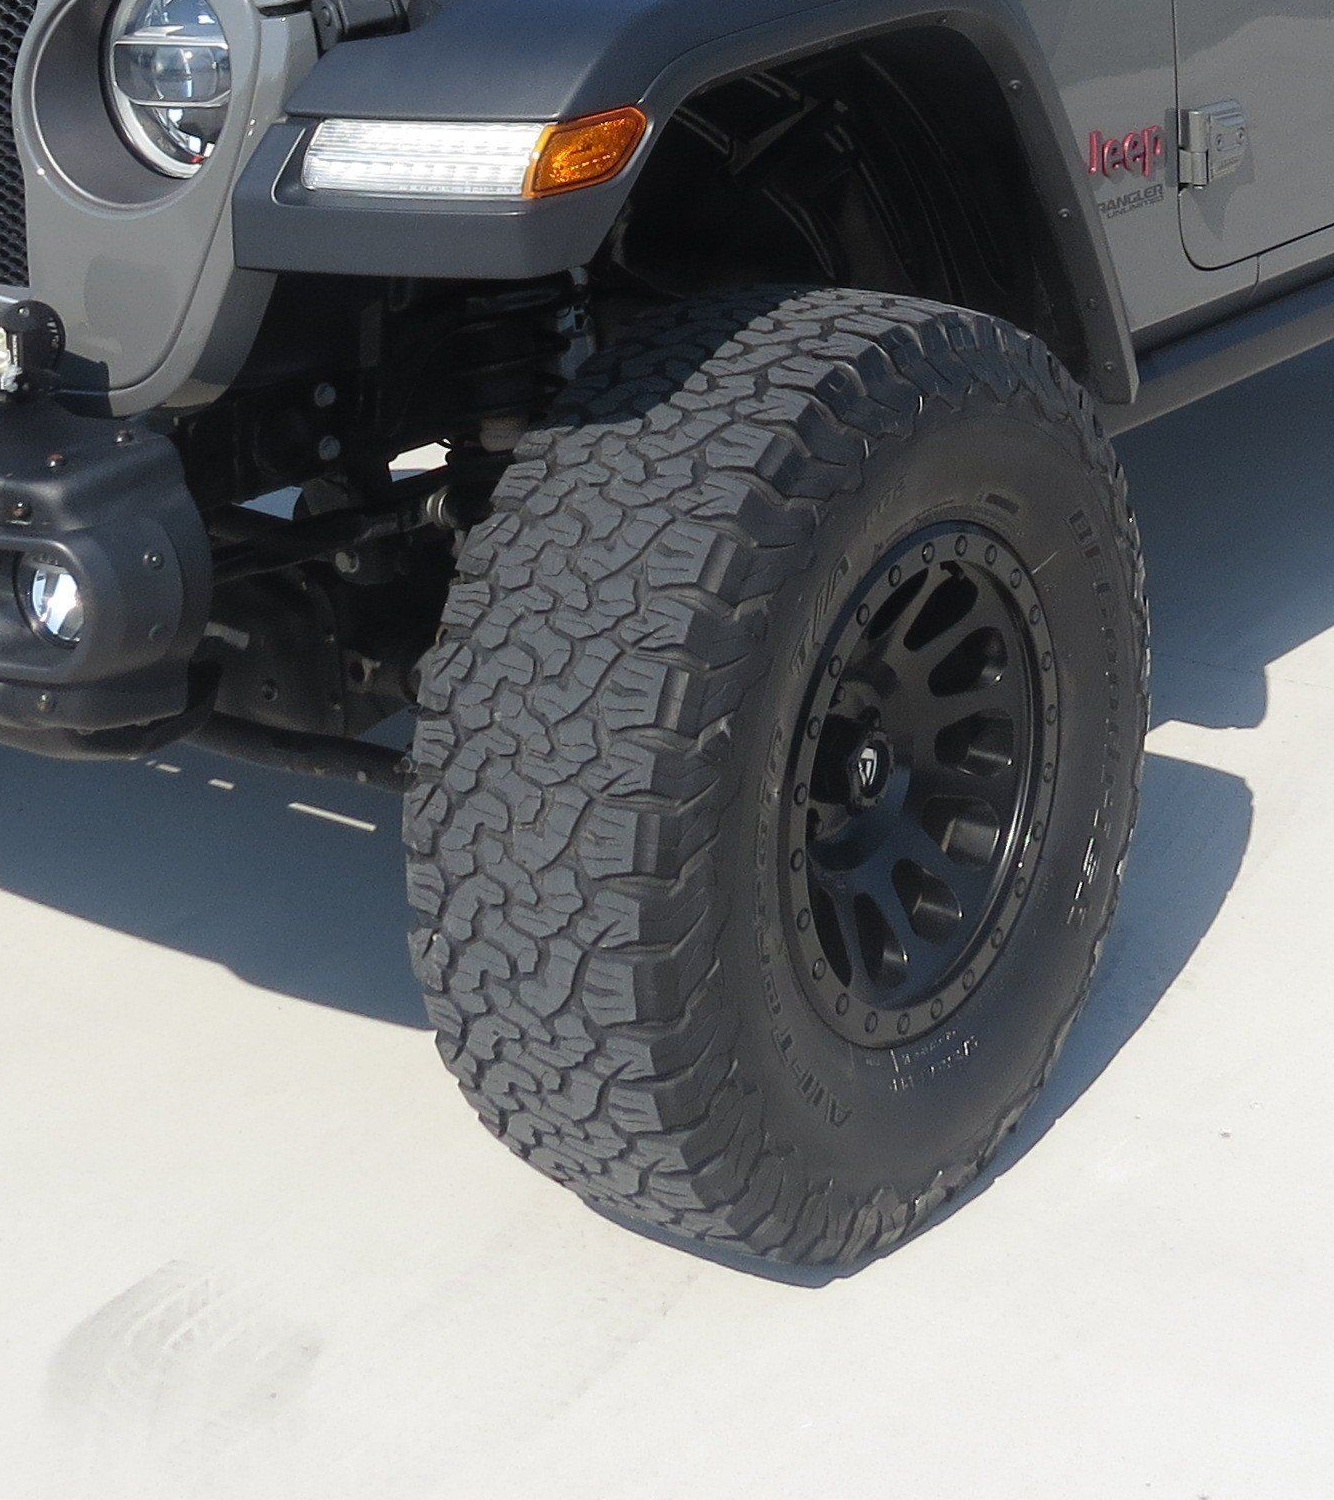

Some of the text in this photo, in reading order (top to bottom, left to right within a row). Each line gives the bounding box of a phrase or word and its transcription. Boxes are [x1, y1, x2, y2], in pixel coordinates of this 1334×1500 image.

[1088, 124, 1163, 177] Jeep
[1097, 183, 1164, 212] RANGLER
[1066, 507, 1120, 930] BFGoodr
